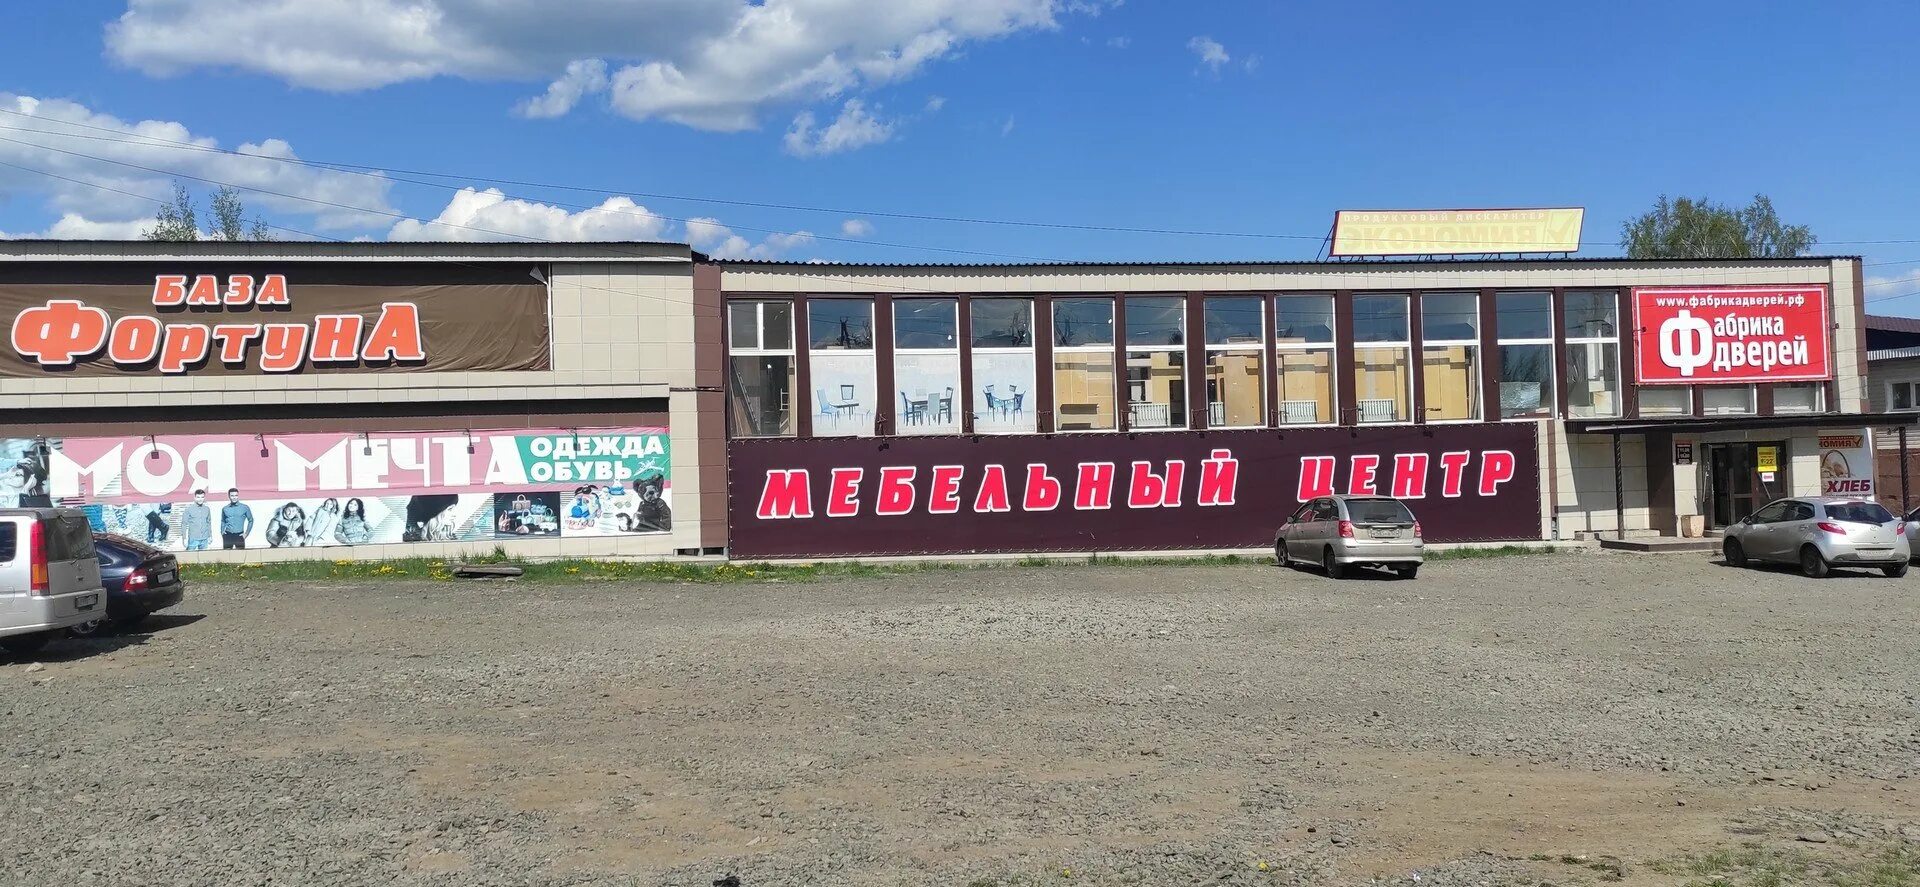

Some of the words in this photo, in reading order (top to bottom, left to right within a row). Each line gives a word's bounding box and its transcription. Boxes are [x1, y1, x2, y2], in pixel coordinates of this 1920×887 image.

[1343, 212, 1449, 222] ПРОДУКТОВЫЙ
[1455, 212, 1546, 222] ДИСКАУНТЕР
[1342, 225, 1538, 250] ЭКОНОМИЯ
[151, 273, 291, 307] БАЗА
[1656, 293, 1805, 309] www.фабрикадверей.рф
[1659, 309, 1785, 377] Фабрика
[1712, 335, 1809, 372] дверей
[530, 436, 665, 460] ОДЕЖДА
[50, 442, 237, 497] МОЯ
[273, 435, 531, 491] МЕЧТА
[530, 460, 632, 482] ОБУВЬ
[755, 448, 1240, 519] МЕБЕЛЬНЫЙ
[1296, 449, 1517, 503] ЦЕНТР
[1826, 480, 1871, 492] ХЛЕБ
